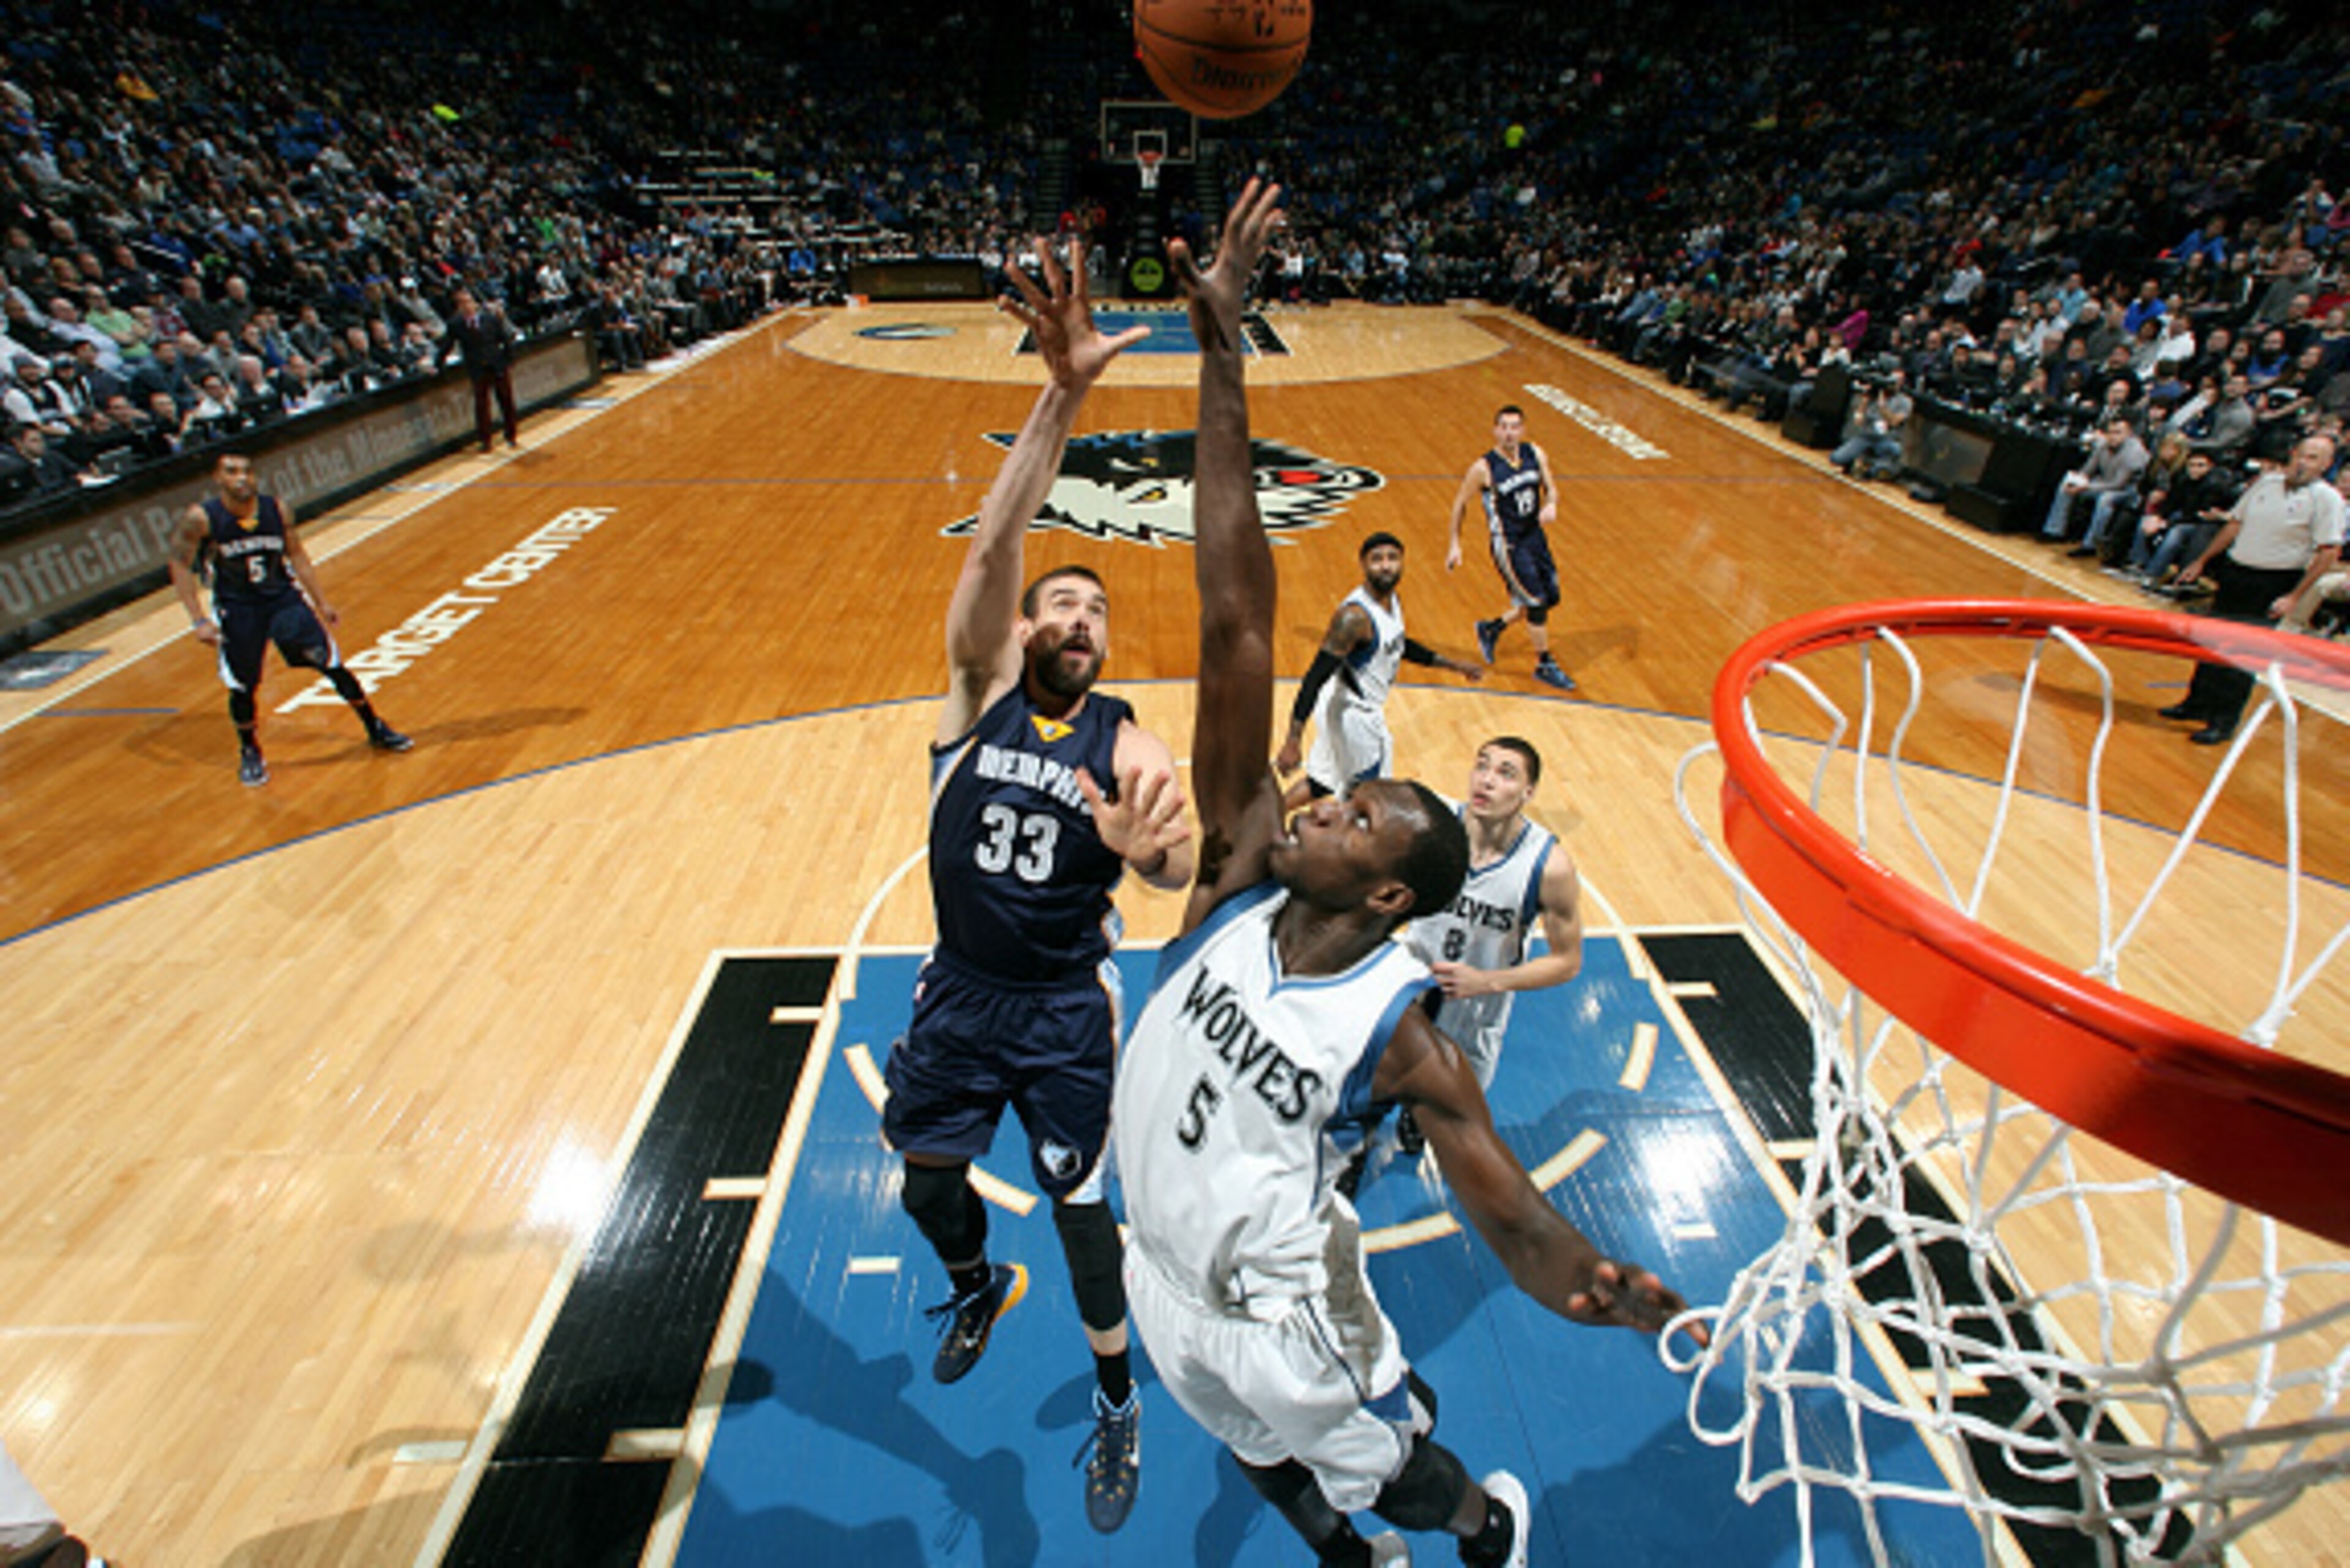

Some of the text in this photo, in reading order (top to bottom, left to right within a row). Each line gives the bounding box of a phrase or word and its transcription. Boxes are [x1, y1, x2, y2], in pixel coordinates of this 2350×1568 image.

[0, 516, 149, 614] Official
[275, 454, 304, 498] of
[305, 441, 349, 490] the
[463, 507, 618, 588] CENTER
[247, 555, 267, 583] 5
[975, 744, 1105, 816] MEMPH
[974, 802, 1061, 883] 33
[1442, 927, 1467, 961] 8
[1444, 901, 1515, 933] LVES
[1174, 961, 1323, 1124] WOLVES
[1177, 1073, 1223, 1154] 5
